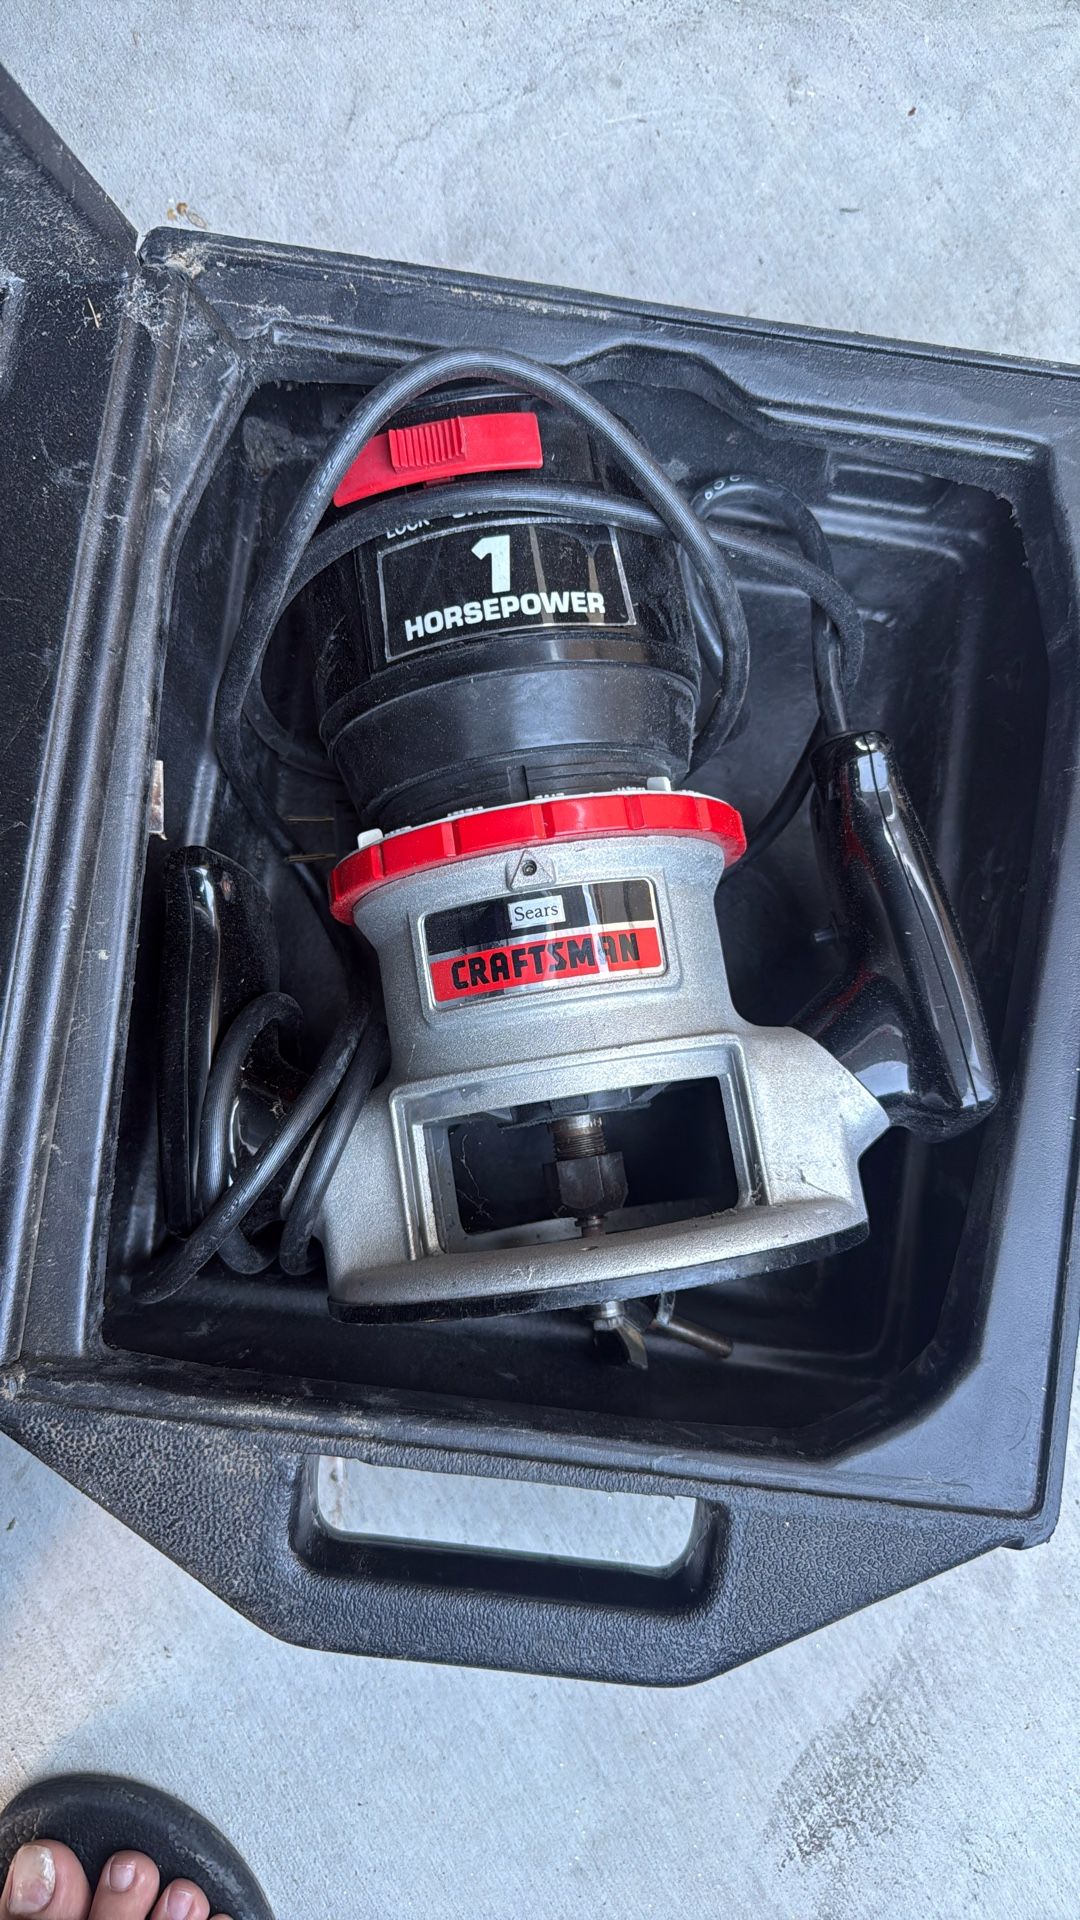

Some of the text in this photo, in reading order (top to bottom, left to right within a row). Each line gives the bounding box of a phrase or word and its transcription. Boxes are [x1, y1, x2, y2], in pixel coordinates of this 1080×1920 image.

[471, 534, 511, 594] 1
[404, 591, 606, 642] HORSEPOWER
[513, 902, 560, 922] Sears
[452, 932, 640, 990] CRAFTSMAN
